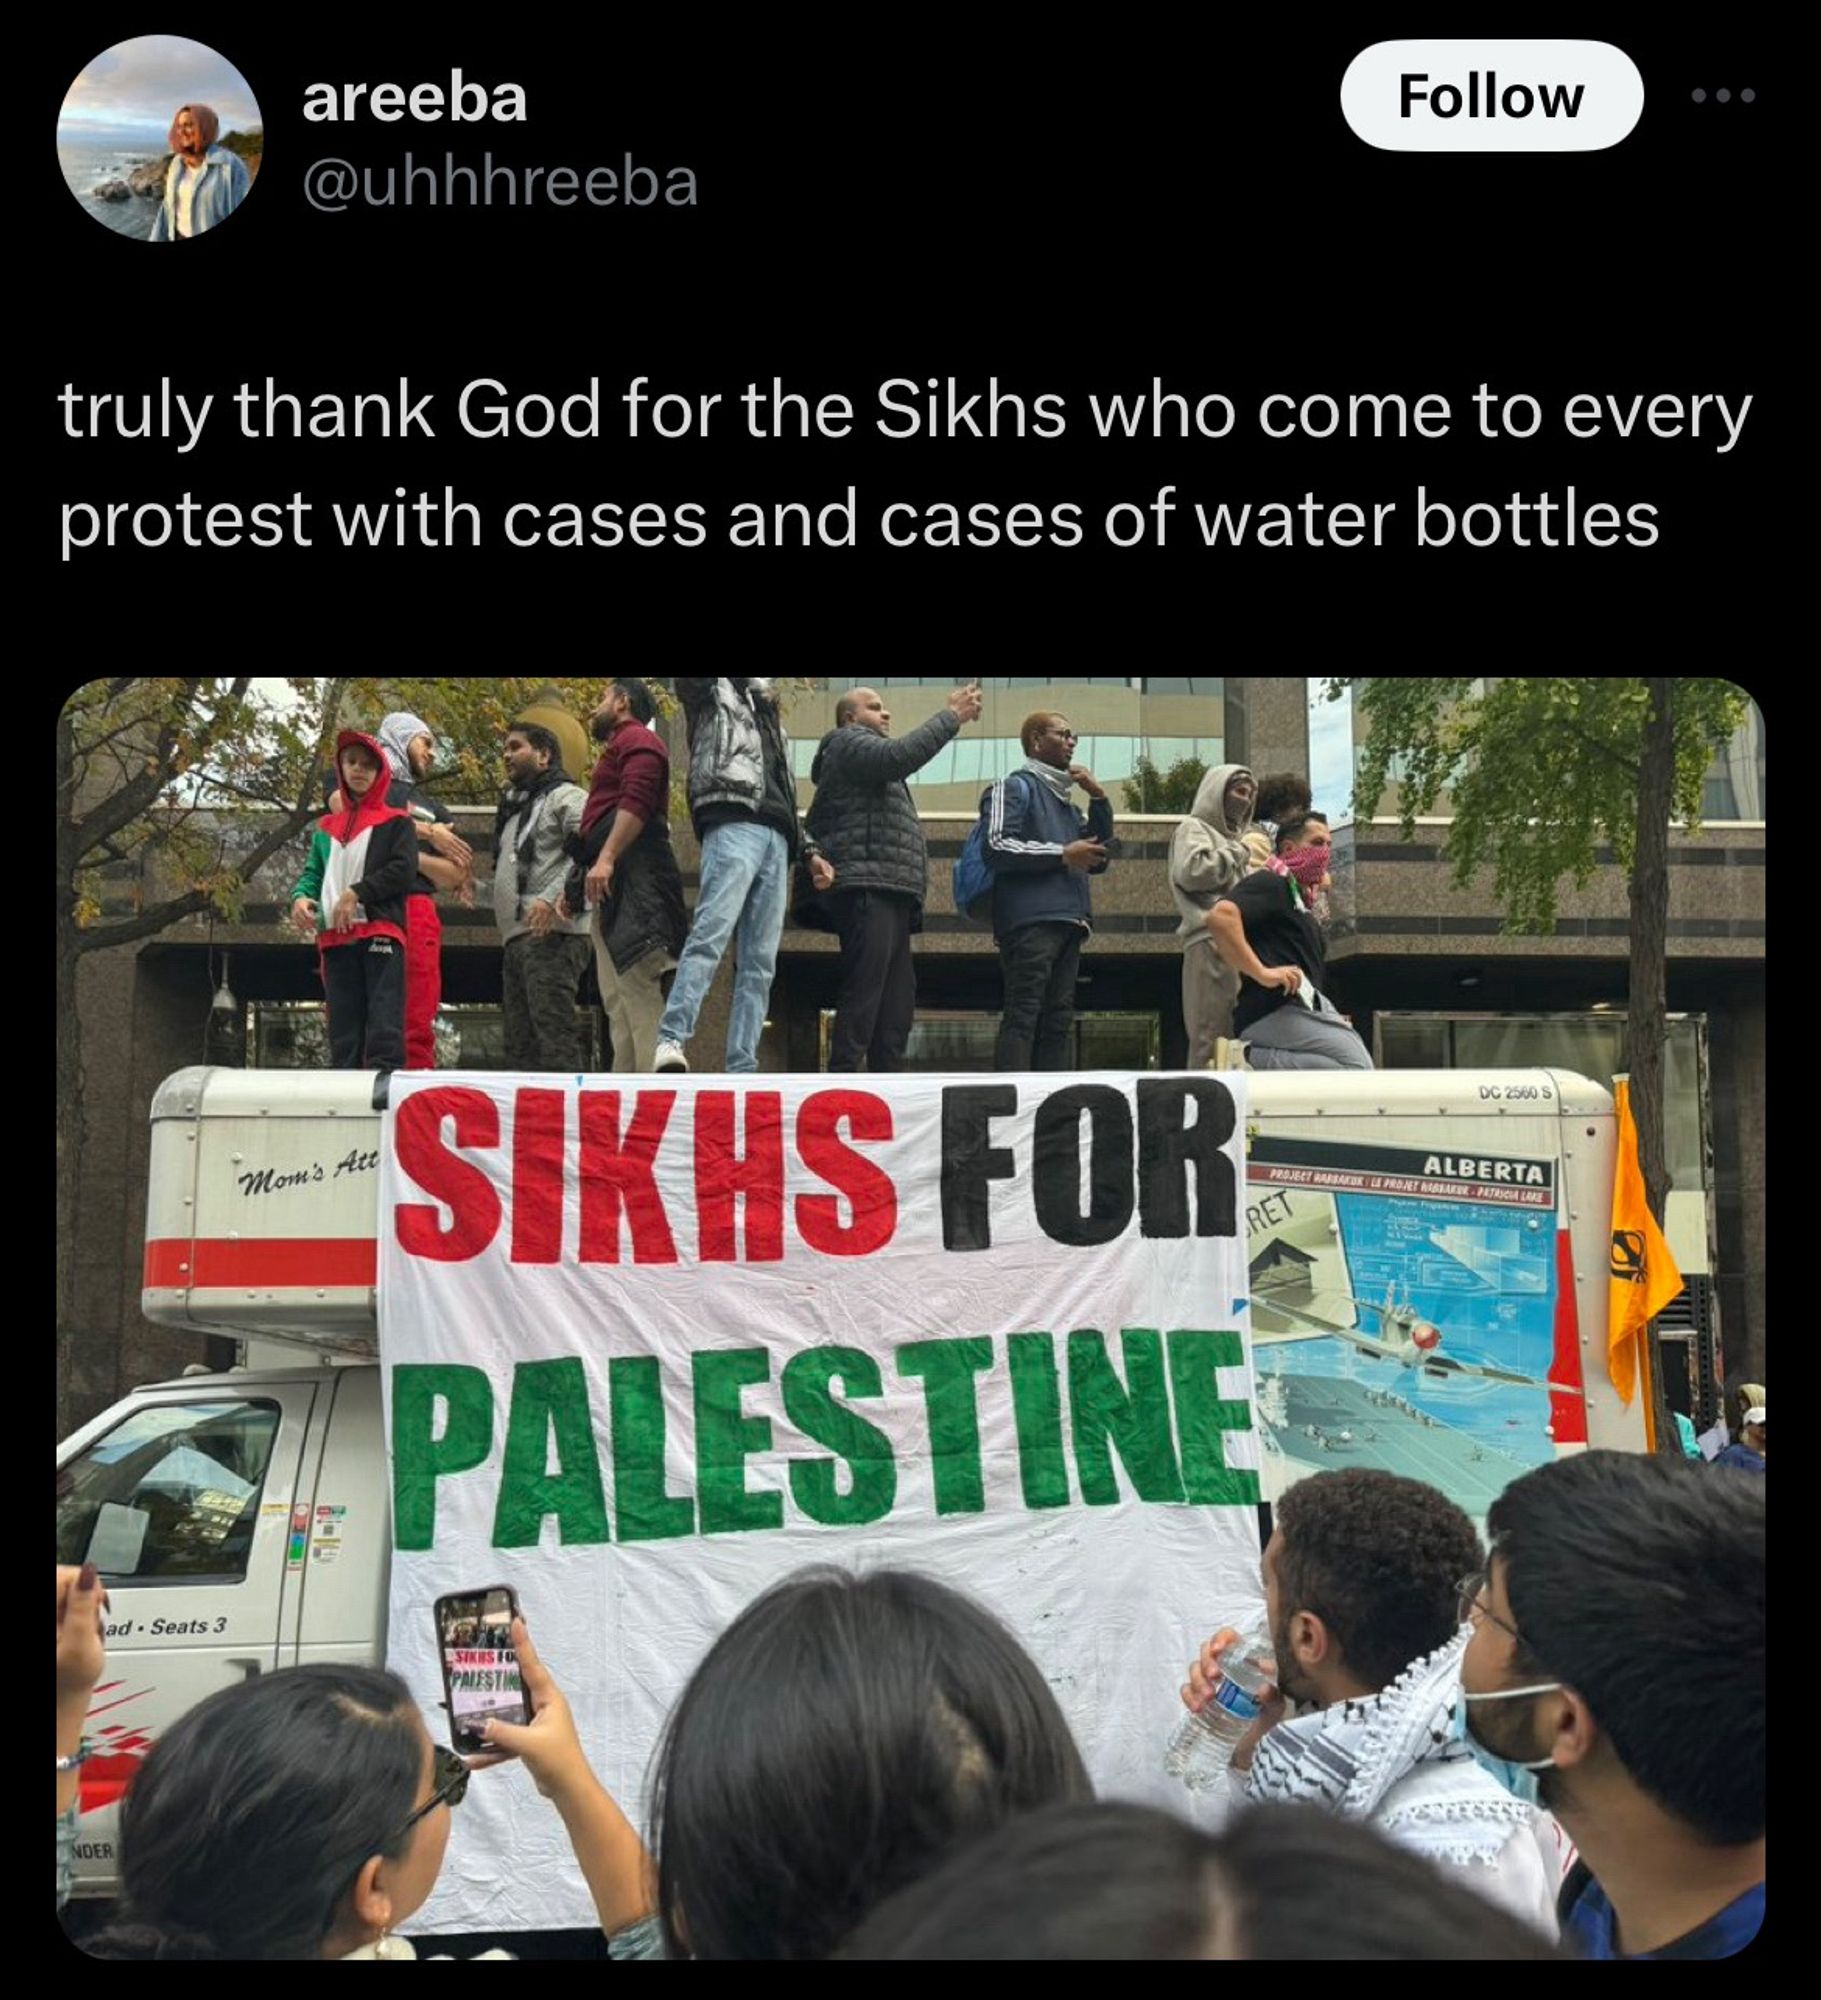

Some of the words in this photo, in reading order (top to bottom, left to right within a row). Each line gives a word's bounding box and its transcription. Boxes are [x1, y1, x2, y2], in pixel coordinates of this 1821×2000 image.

[238, 1162, 325, 1197] Mom's
[394, 1086, 897, 1265] SIKHS
[940, 1076, 1237, 1251] FOR
[1269, 1168, 1313, 1182] PROJECT
[1383, 1177, 1419, 1192] PROJET
[1424, 1155, 1544, 1185] ALBERTA
[1246, 1190, 1294, 1238] RET
[393, 1328, 1263, 1551] PALESTINE
[150, 1617, 209, 1636] Seats
[213, 1616, 228, 1634] 3
[455, 1649, 495, 1667] SIKHS
